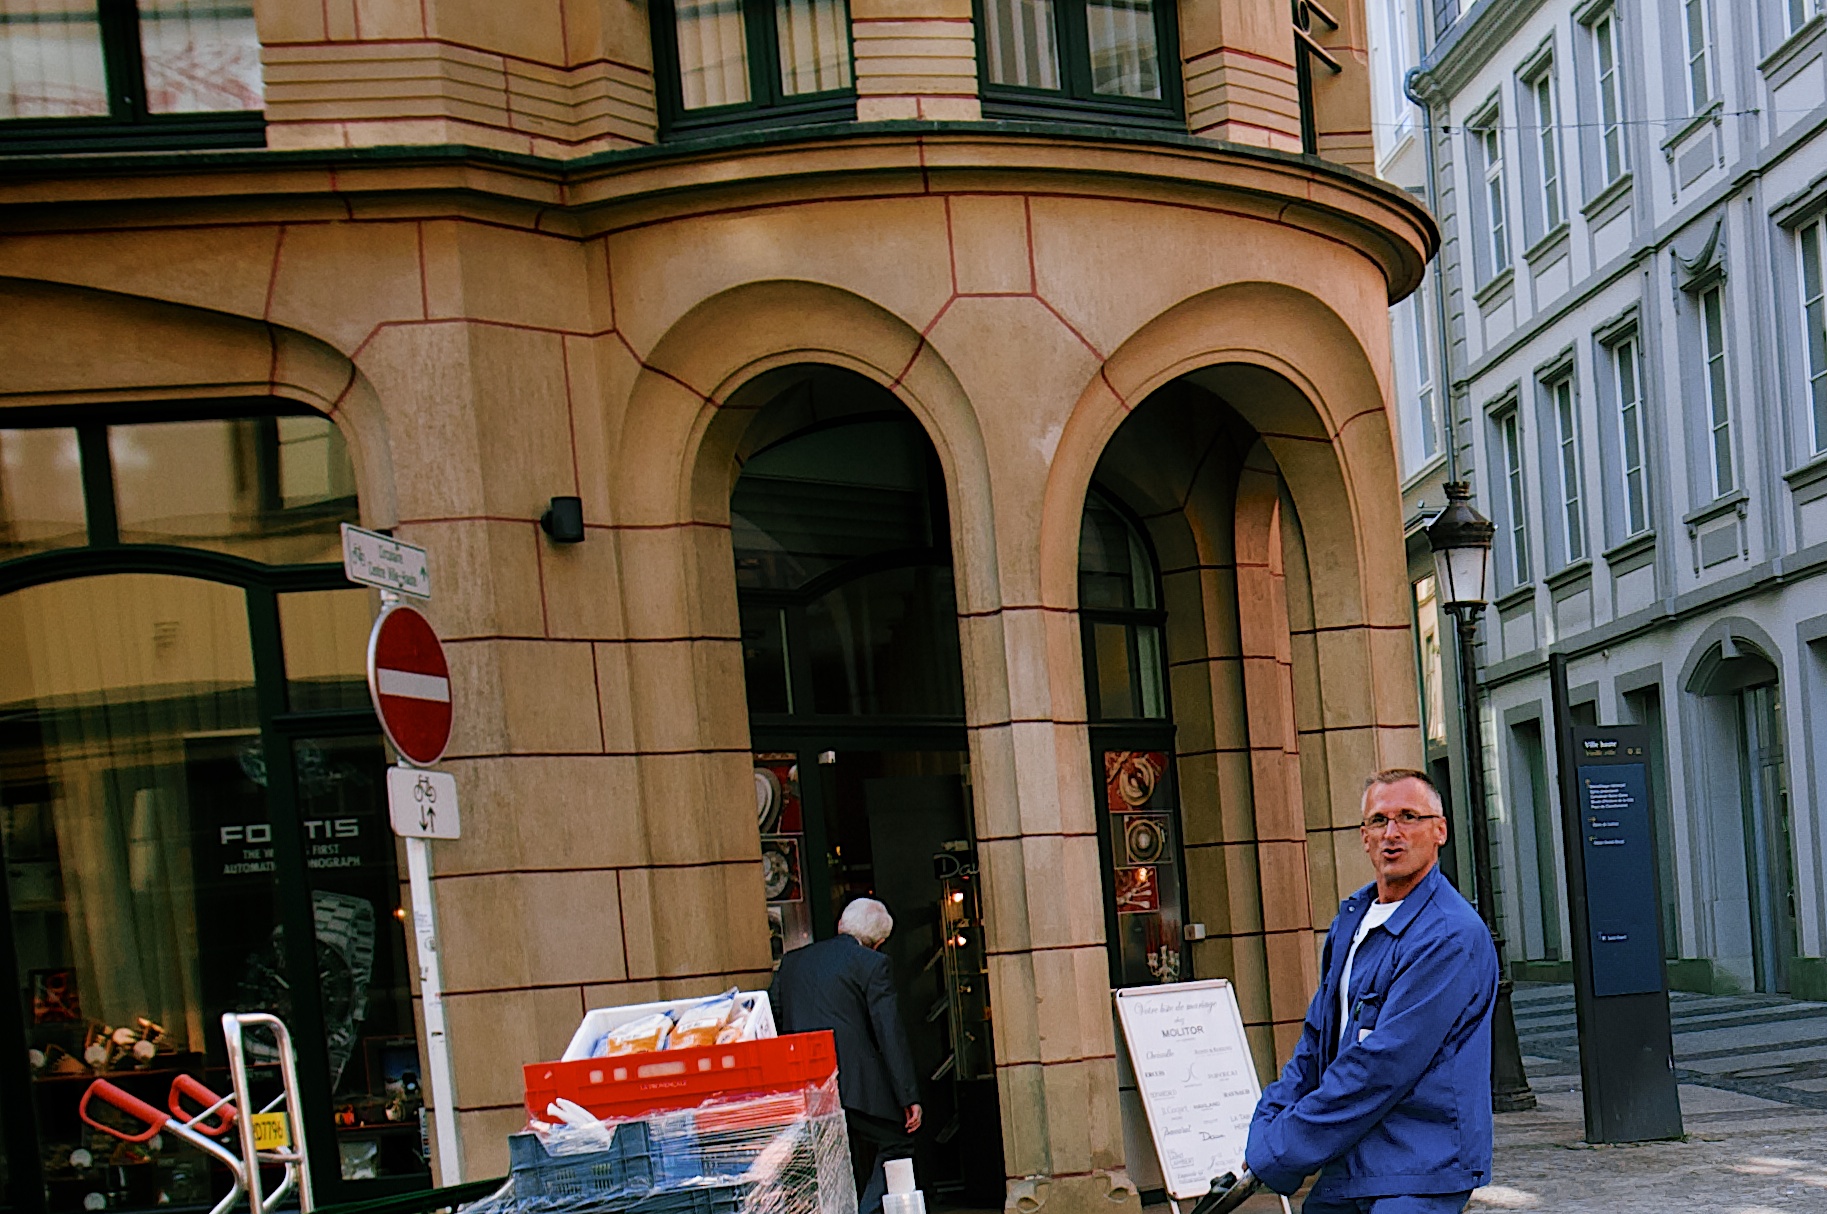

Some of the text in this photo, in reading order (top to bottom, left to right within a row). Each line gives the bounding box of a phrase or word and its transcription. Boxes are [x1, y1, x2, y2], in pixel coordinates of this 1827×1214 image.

[220, 818, 359, 845] FOTIS
[223, 861, 276, 874] AUTOMATI
[1161, 1025, 1204, 1038] MOLITOR
